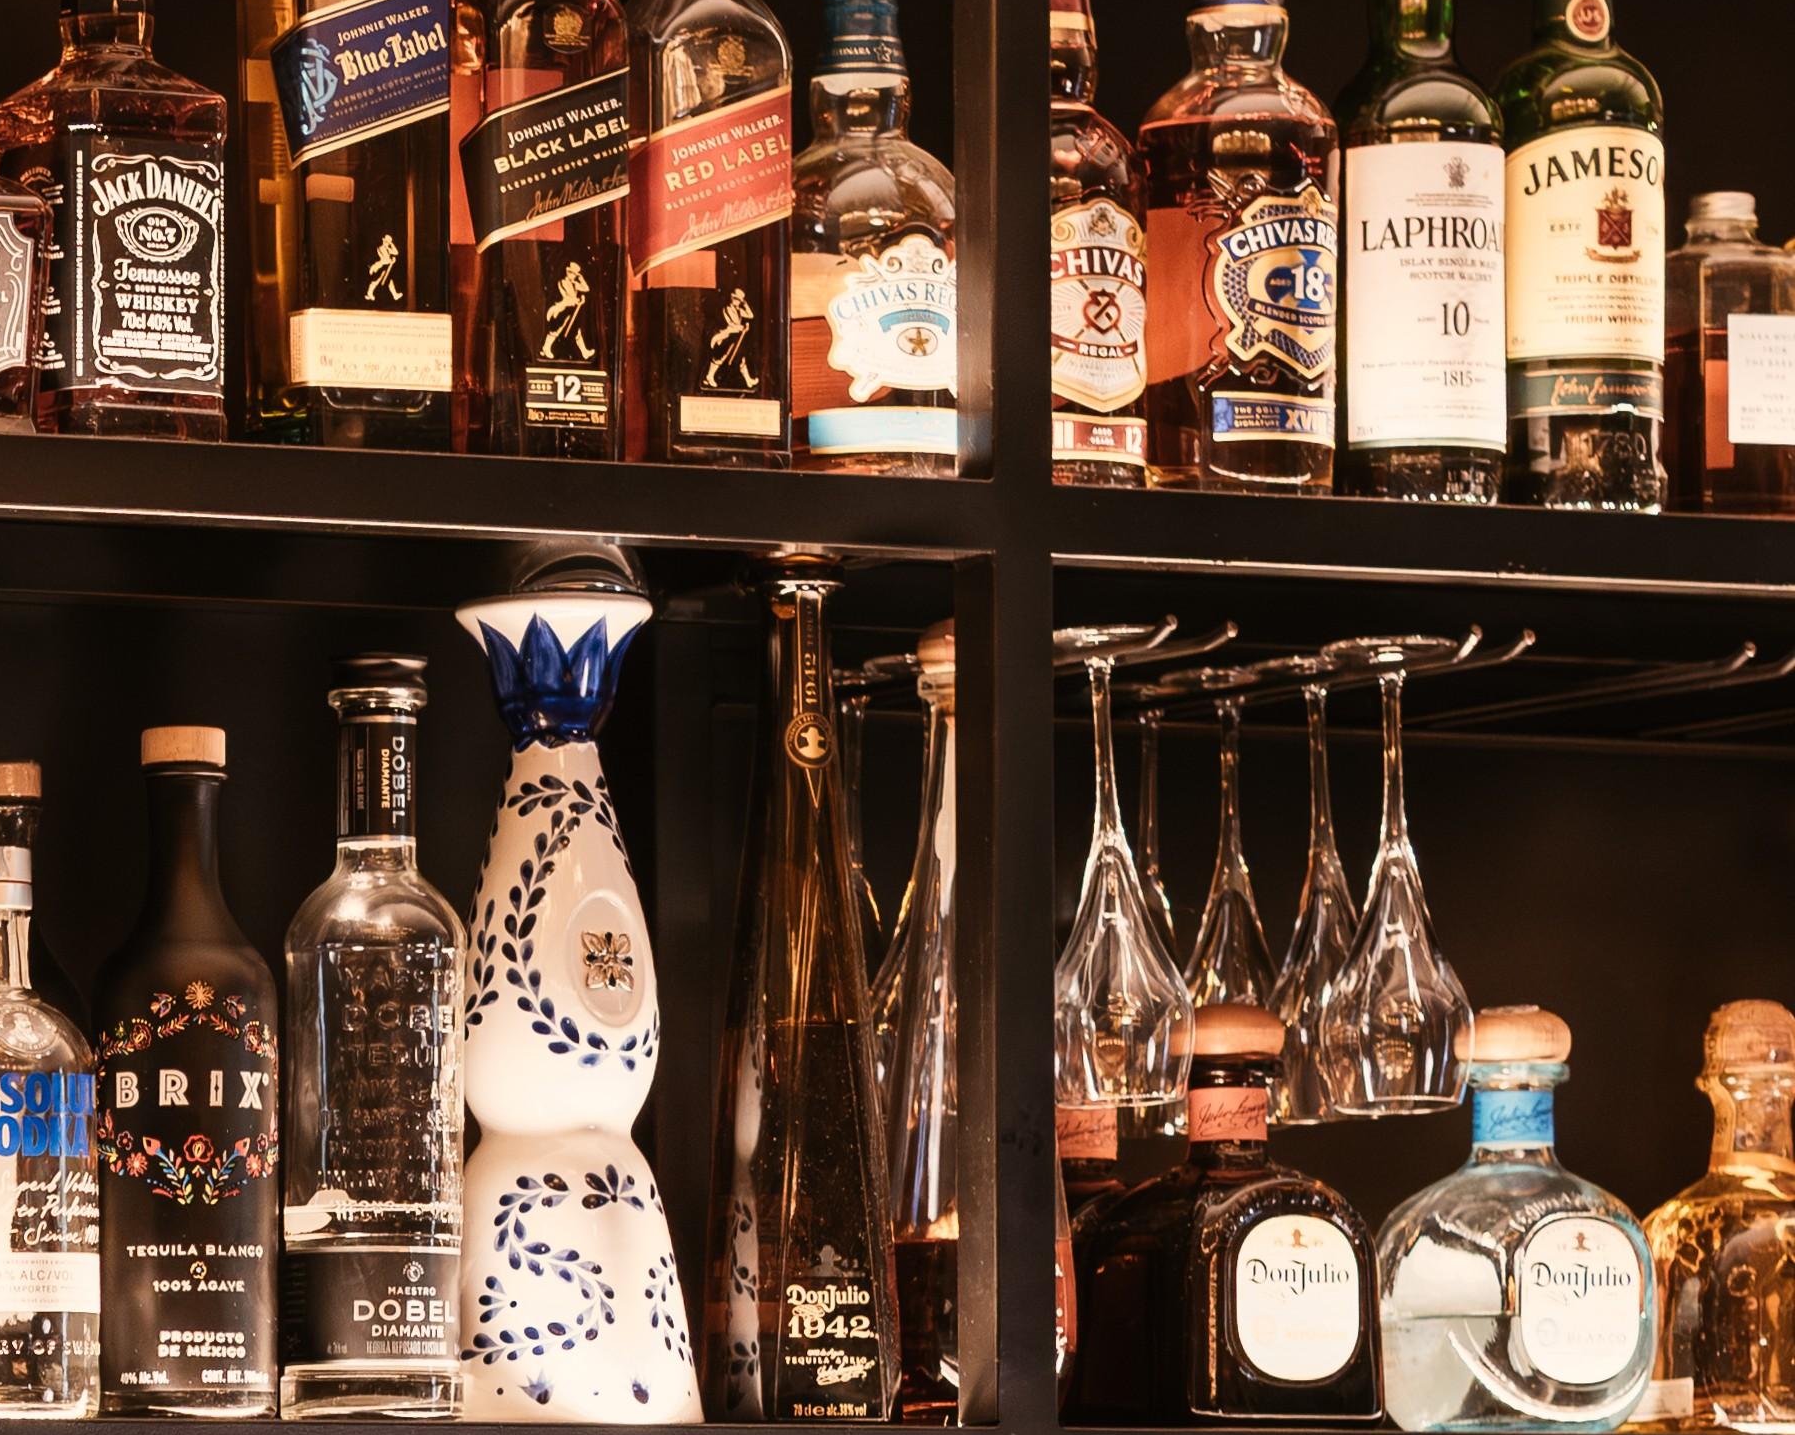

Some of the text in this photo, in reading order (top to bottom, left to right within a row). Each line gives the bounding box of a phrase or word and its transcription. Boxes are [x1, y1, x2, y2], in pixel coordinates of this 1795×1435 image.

[337, 5, 430, 47] JOHNNIE WALKER
[333, 22, 448, 86] Blue Label
[333, 87, 375, 108] BLENDED
[376, 76, 412, 93] SCOTCH
[493, 115, 631, 174] BLACK LABEL
[507, 116, 566, 149] JOHNNIE
[664, 133, 790, 193] RED LABEL
[671, 132, 731, 166] JOHNNIE
[499, 171, 547, 194] BLENDED
[551, 157, 590, 176] SCOTCH
[1523, 146, 1659, 196] JAMESO
[76, 196, 84, 220] DROP
[89, 161, 223, 225] JACK DANIEL'S
[665, 189, 712, 212] BLENDED
[715, 175, 755, 193] SCOTCH
[137, 225, 177, 244] No.7
[147, 216, 167, 227] Old
[1361, 216, 1500, 253] LAPHROA
[1229, 218, 1315, 258] CHIVAS
[113, 257, 201, 287] Tennessee
[1051, 248, 1143, 287] CHIVAS
[1399, 257, 1434, 267] ISLAY
[1408, 271, 1455, 281] SCOTCH
[1291, 264, 1325, 302] 18
[114, 292, 200, 314] WHISKEY
[836, 282, 918, 320] CHIVAS
[1254, 303, 1298, 322] BLENDED
[120, 311, 194, 333] 70cl 40% Vol.
[1441, 300, 1471, 337] 10
[1078, 344, 1123, 358] REGAL
[553, 375, 582, 402] 12
[1442, 369, 1474, 387] 1815
[1550, 375, 1590, 406] John
[1234, 405, 1251, 414] THE
[1125, 425, 1143, 455] 12
[804, 652, 818, 704] 1942
[381, 748, 391, 809] DIAMANTE
[392, 736, 406, 828] DOBEL
[115, 1068, 264, 1110] BRIX
[126, 1244, 264, 1259] TEQUILA BLANCO
[152, 1280, 246, 1293] 100% AGAVE
[387, 1286, 437, 1297] MAESTRO
[352, 1299, 456, 1324] DOBEL
[159, 1329, 245, 1345] PRODUCTO
[371, 1324, 445, 1339] DIAMANTE
[157, 1341, 247, 1359] DE MÉXICO
[784, 1356, 830, 1365] TEQUILA
